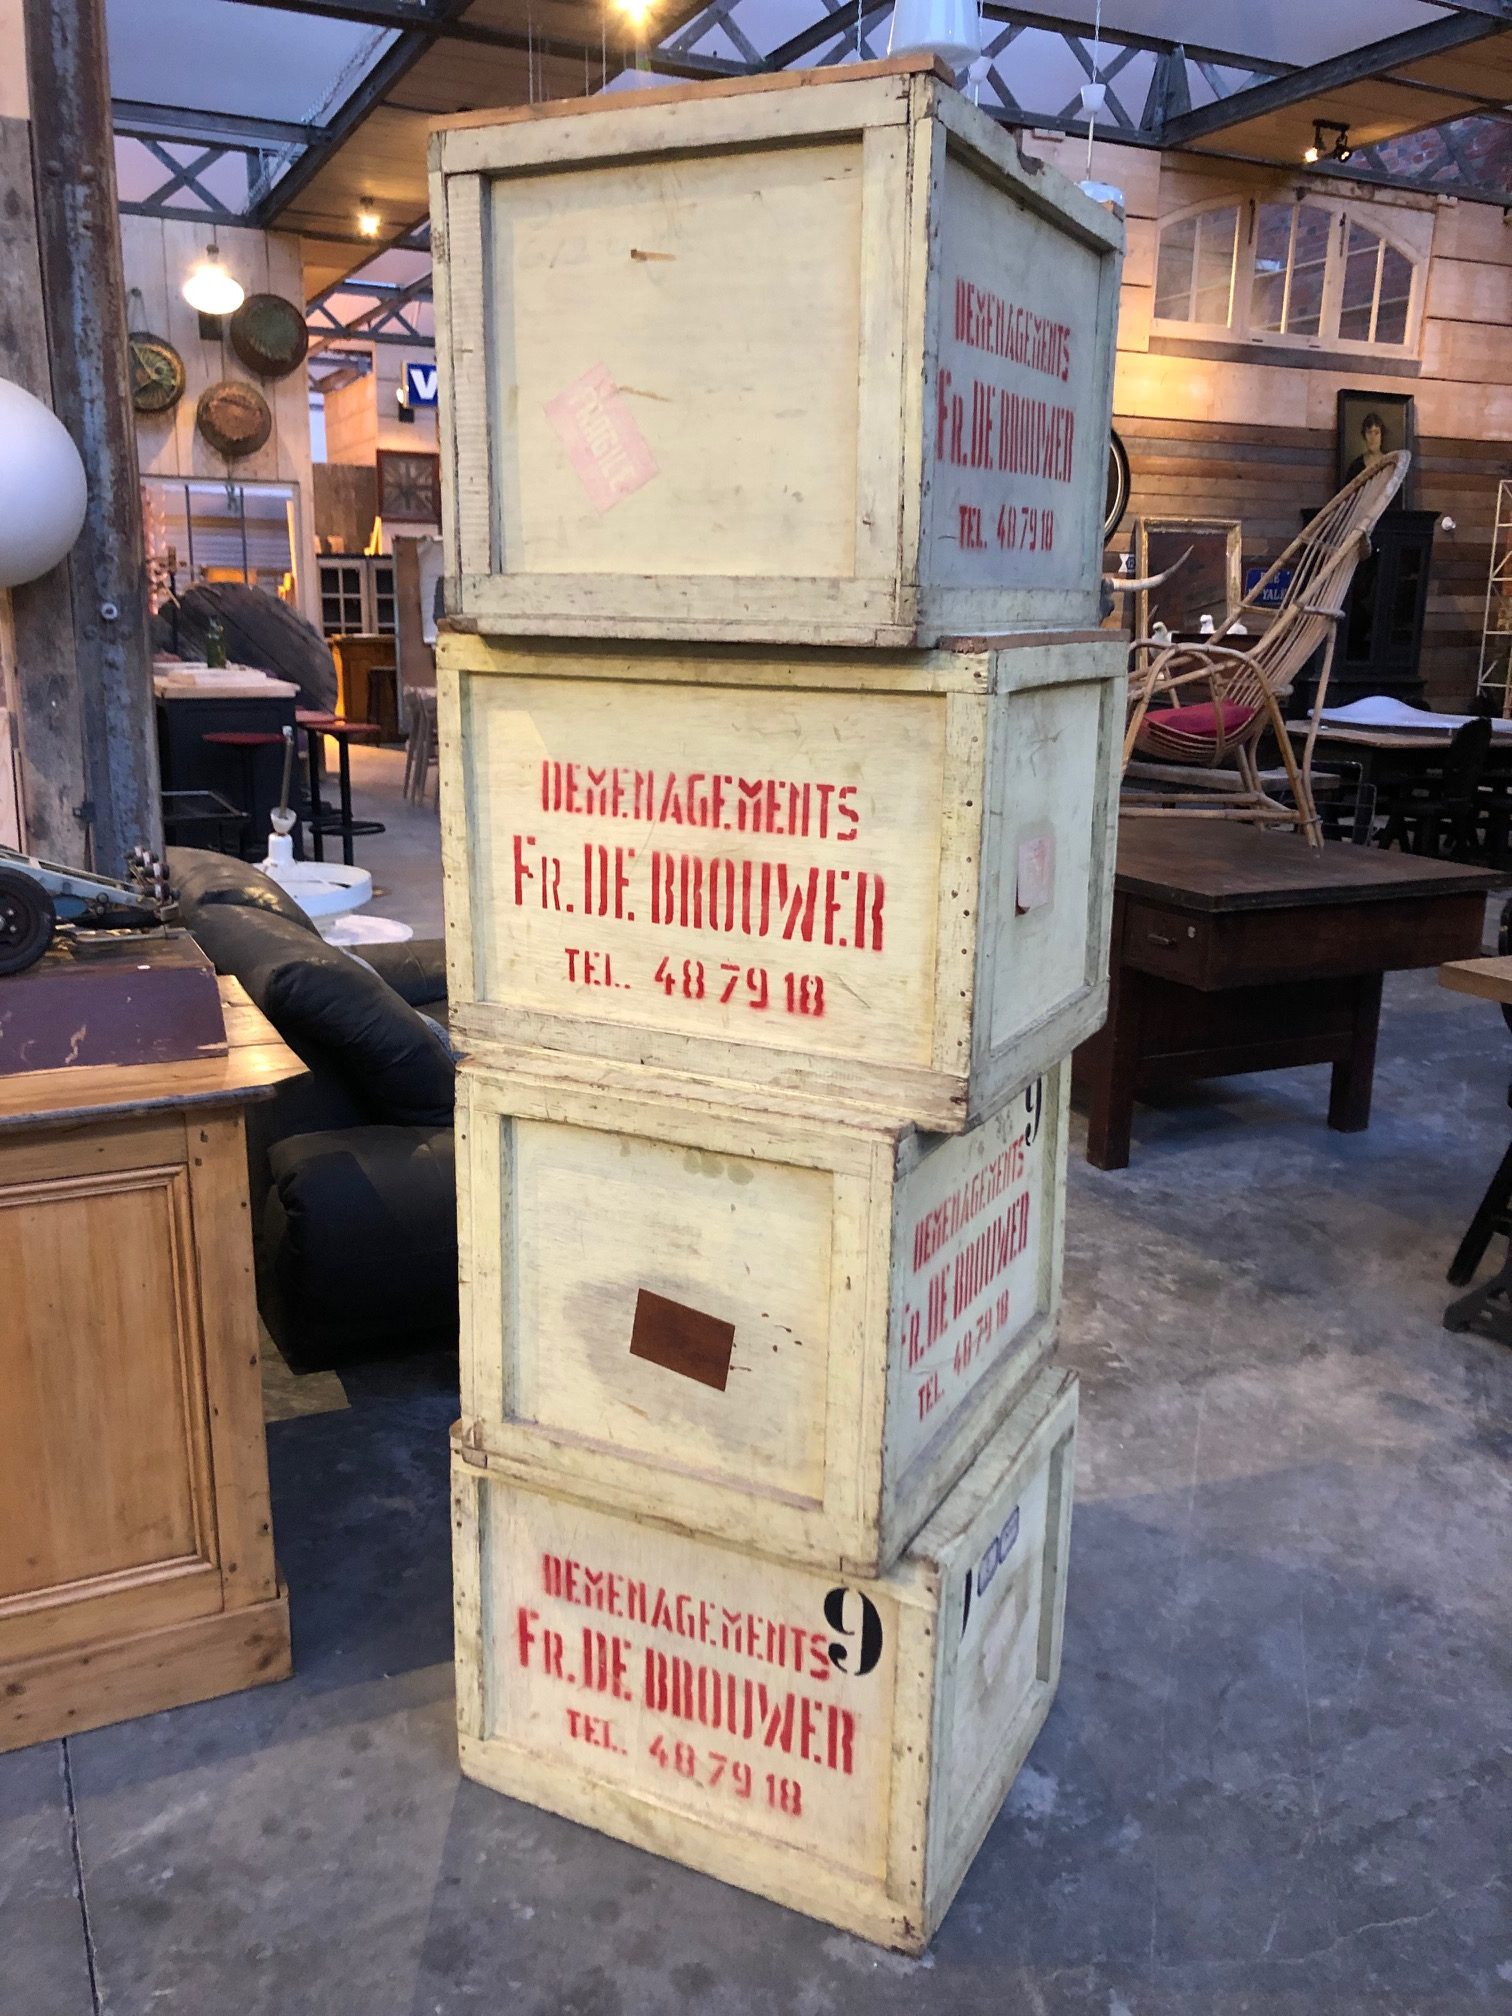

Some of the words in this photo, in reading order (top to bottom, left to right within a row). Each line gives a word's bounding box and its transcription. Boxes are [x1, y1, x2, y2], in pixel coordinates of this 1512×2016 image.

[955, 277, 1070, 382] DEMENAGEMENTS
[999, 389, 1075, 483] BROUWER
[959, 504, 987, 550] TEL.
[542, 760, 859, 841] DEMENAGEMENTS
[651, 850, 885, 951] BROUWER
[565, 948, 630, 989] TEL.
[912, 1134, 1024, 1274] DEMENAGEMENTS
[953, 1191, 1029, 1320] BROUWER
[543, 1553, 830, 1681] DEMENAGEMENTS
[824, 1587, 883, 1676] 9
[566, 1708, 628, 1756] TEL.
[645, 1647, 855, 1776] BROUWER
